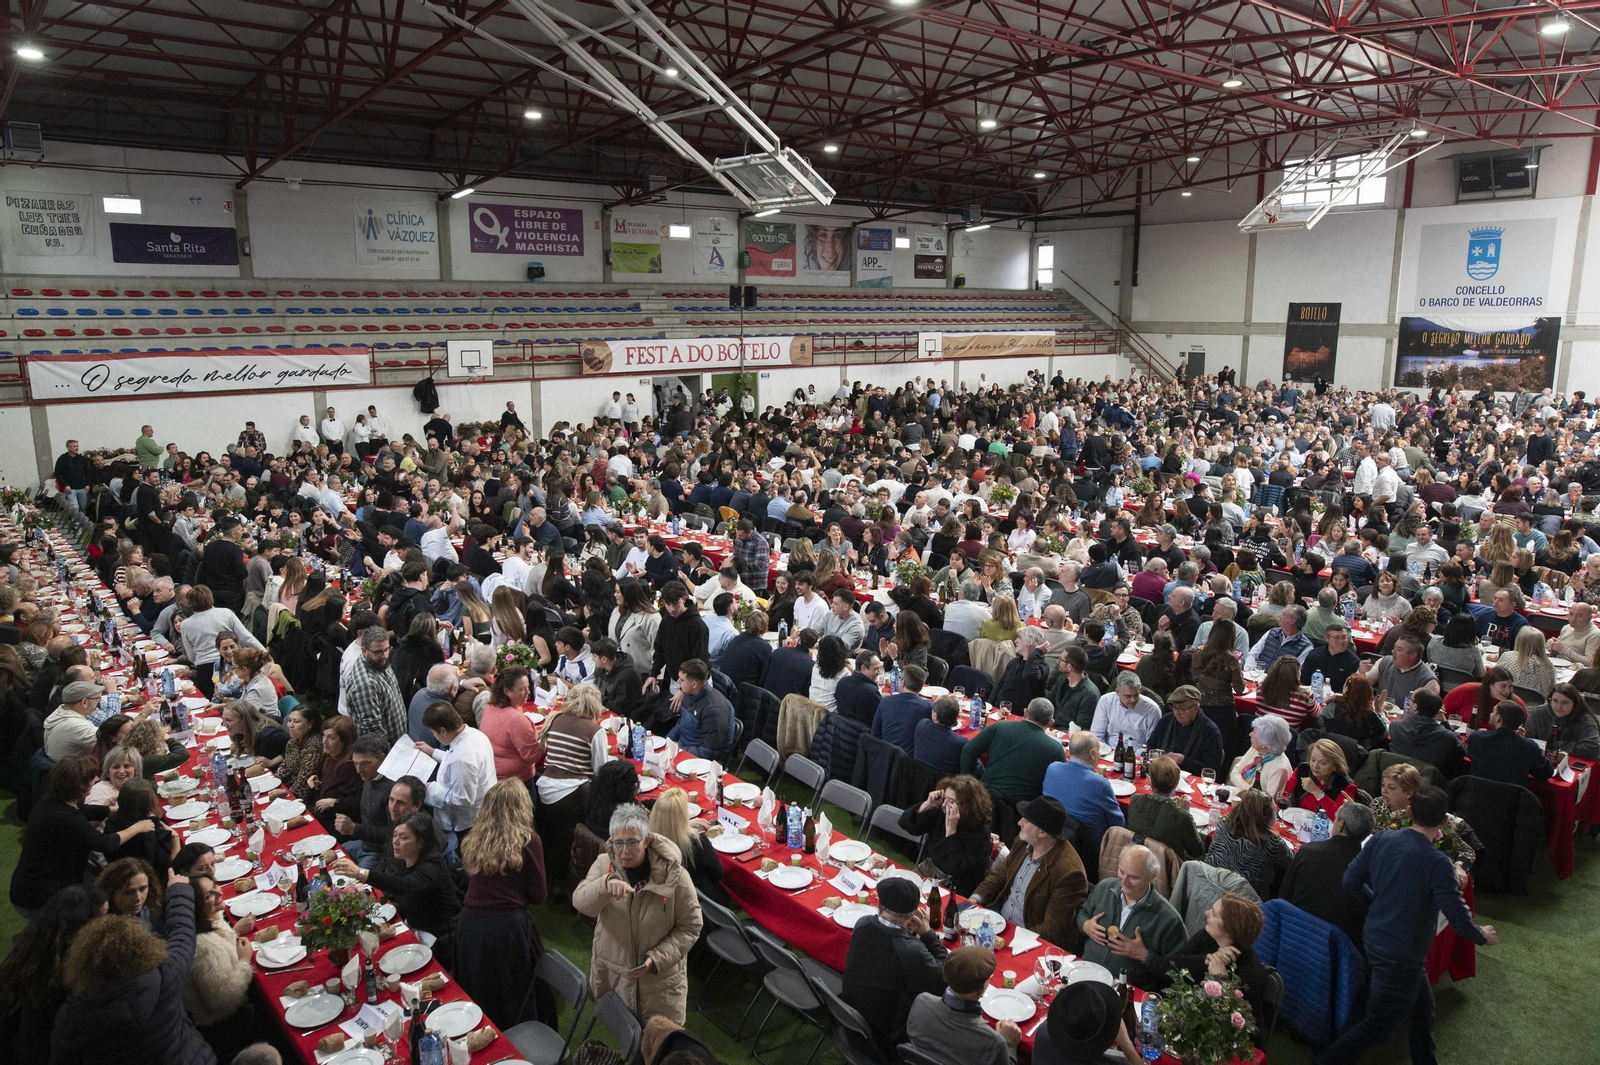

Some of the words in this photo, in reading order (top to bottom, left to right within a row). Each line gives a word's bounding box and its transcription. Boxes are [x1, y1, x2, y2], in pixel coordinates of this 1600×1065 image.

[6, 196, 75, 210] PIZARRAS
[19, 211, 44, 223] LOS
[47, 212, 80, 224] TRES
[513, 208, 561, 220] ESPAZO
[21, 222, 83, 236] CUÑADOS
[514, 220, 549, 230] LIBRE
[552, 221, 567, 231] DE
[627, 228, 658, 236] VICTORIA
[514, 231, 580, 242] VIOLENCIA
[146, 241, 180, 253] Santa
[183, 242, 207, 254] Rita
[515, 242, 579, 253] MACHISTA
[1455, 285, 1505, 295] CONCELLO
[1419, 298, 1426, 307] O
[1428, 297, 1459, 307] BARCO
[1462, 297, 1475, 307] DE
[1478, 296, 1543, 306] VALDEORRAS
[1300, 306, 1328, 320] BOTELO
[1422, 332, 1428, 344] O
[1431, 332, 1461, 344] SEGREDO
[1463, 332, 1492, 345] MELLOR
[1495, 332, 1531, 346] GARDADO
[624, 345, 683, 366] FESTA
[687, 344, 713, 363] DO
[716, 342, 781, 362] BOTELO
[80, 364, 111, 392] O
[113, 368, 197, 392] segredo
[277, 362, 352, 388] gardado
